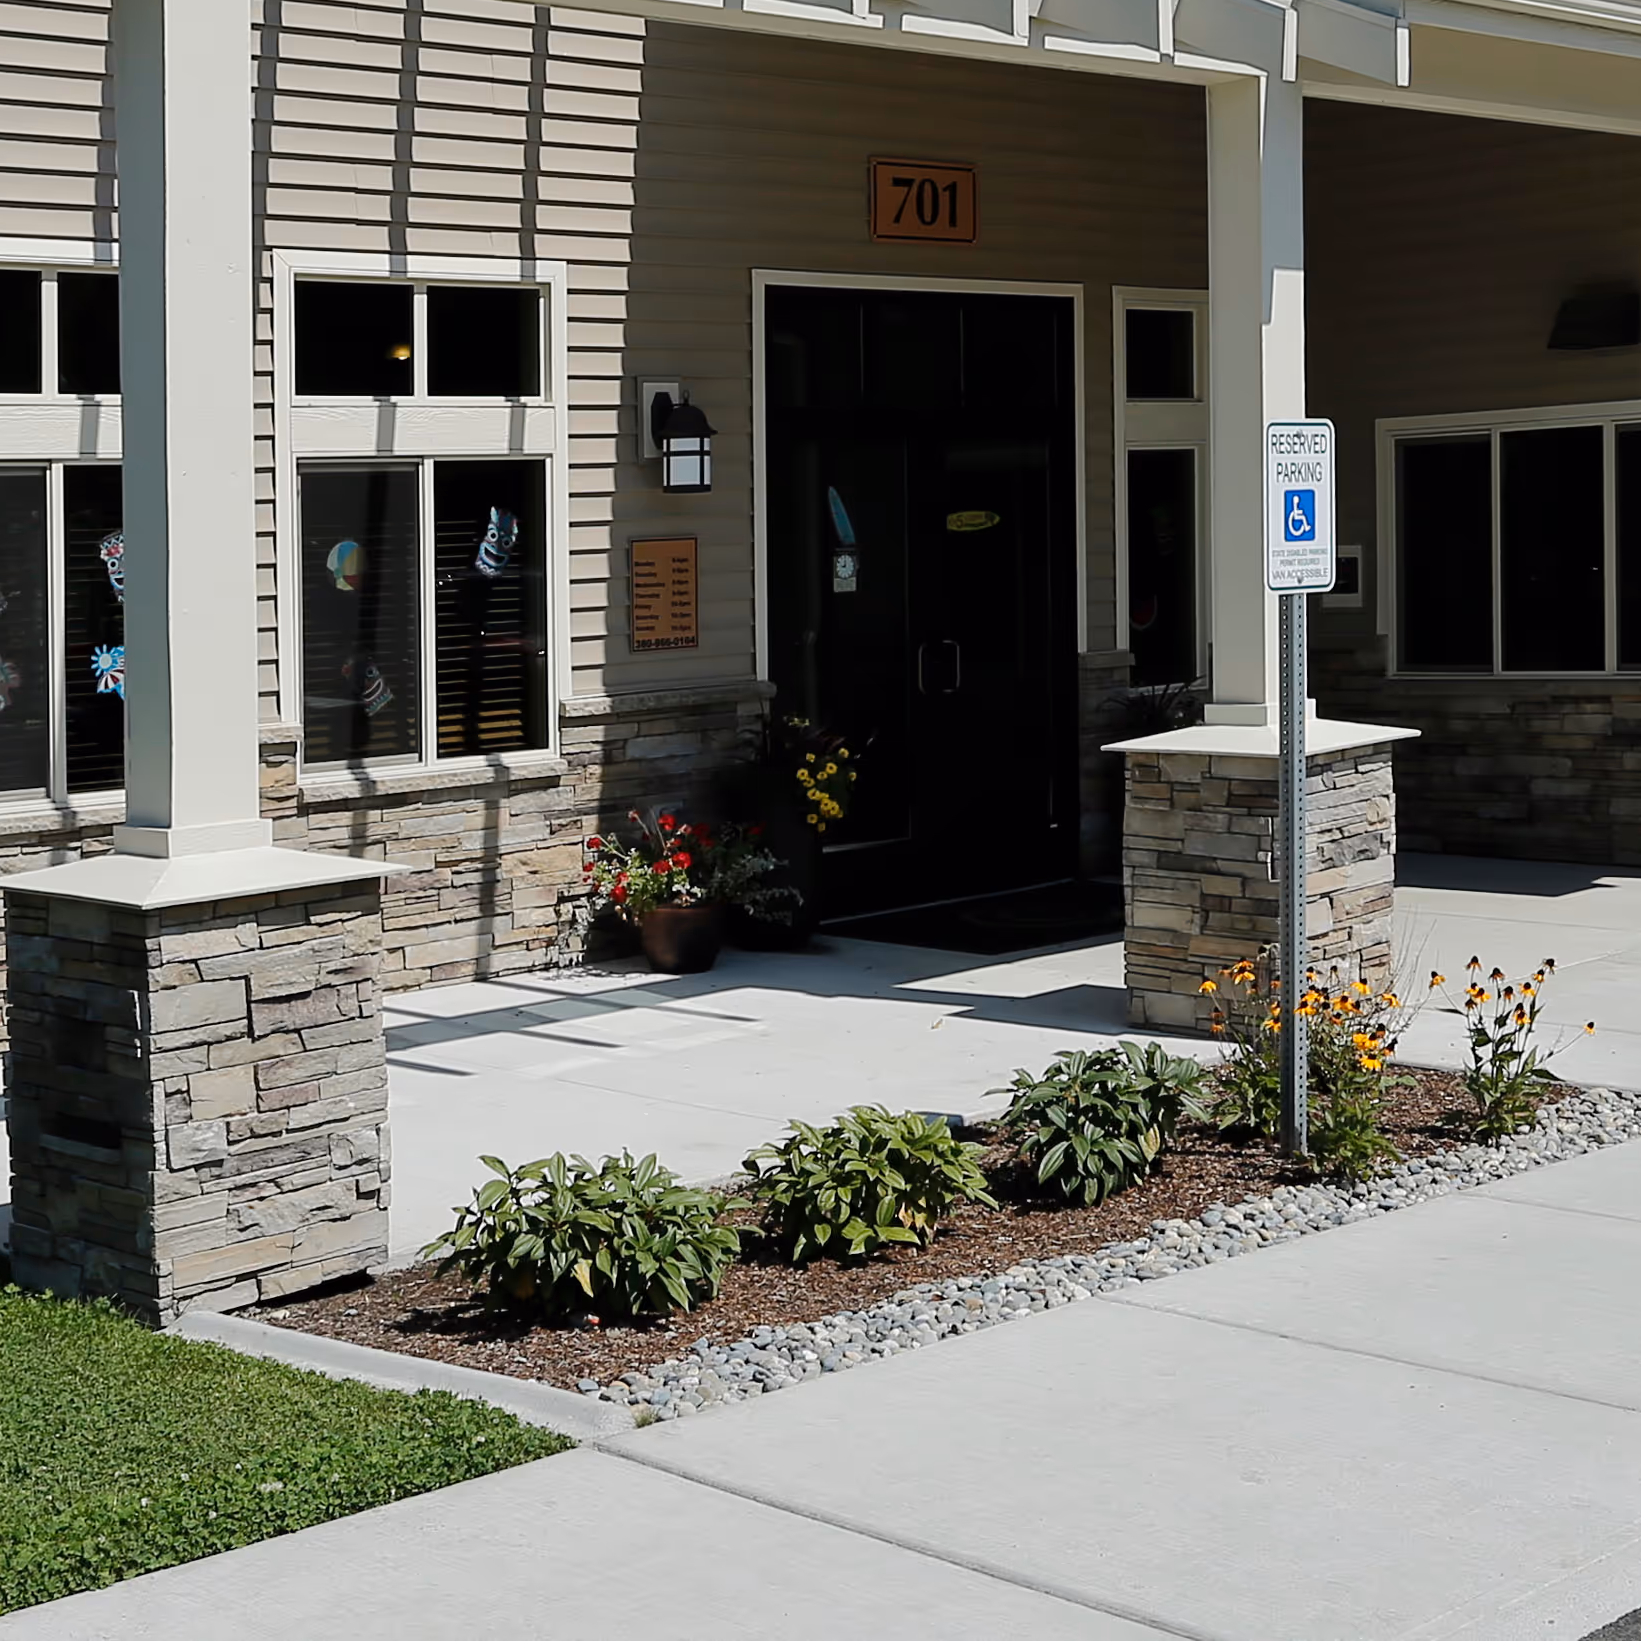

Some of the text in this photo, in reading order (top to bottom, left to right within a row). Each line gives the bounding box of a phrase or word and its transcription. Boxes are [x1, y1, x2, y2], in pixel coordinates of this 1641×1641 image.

[891, 177, 958, 228] 701
[1271, 434, 1328, 455] RESERVED
[1276, 462, 1323, 483] PARKING
[1272, 568, 1329, 580] VAN ACCESSIBLE
